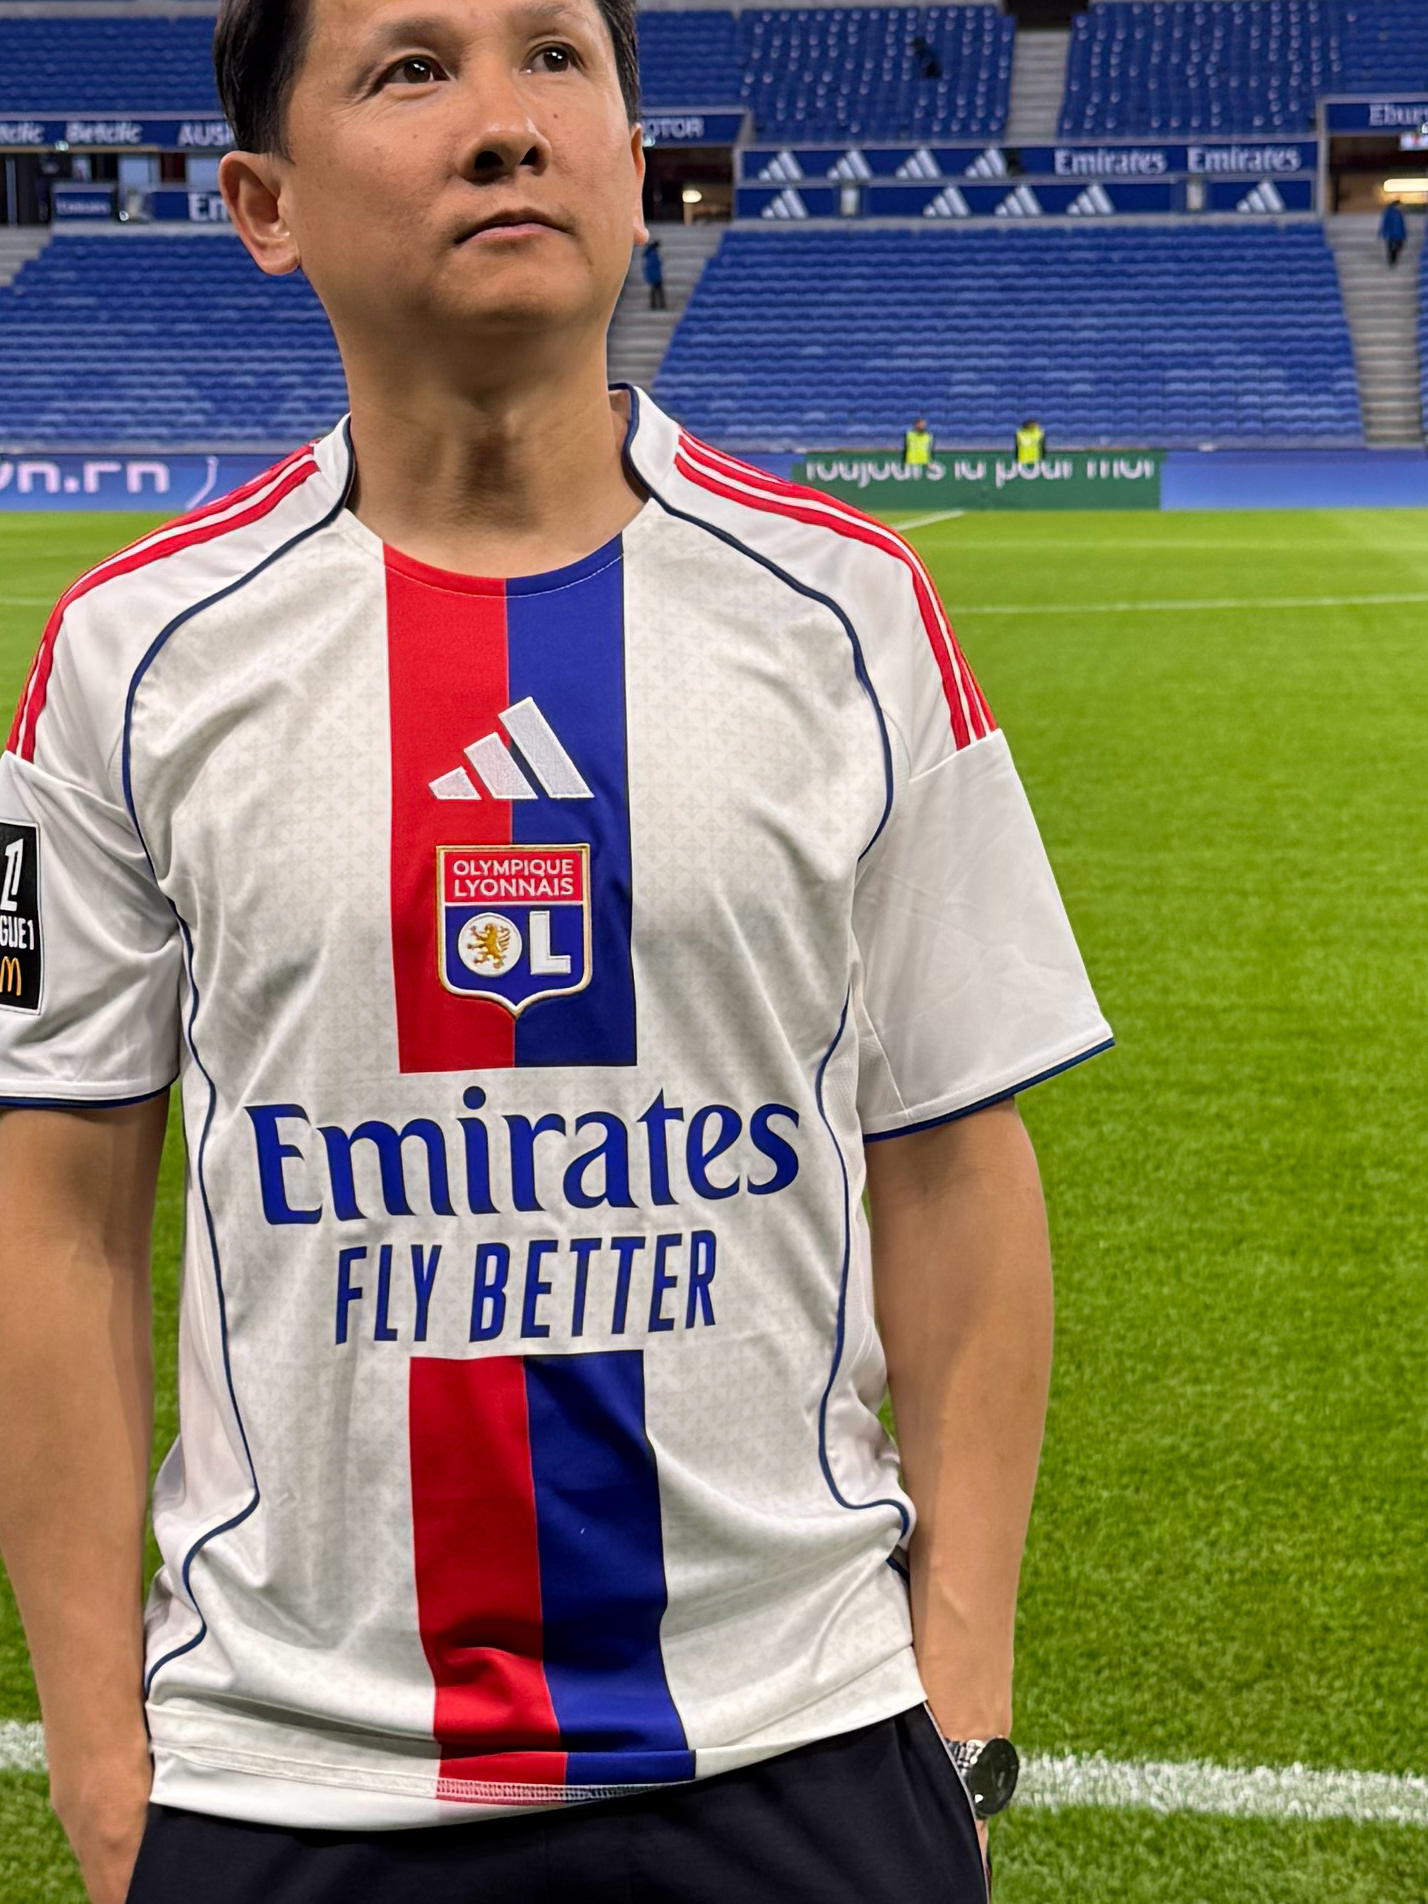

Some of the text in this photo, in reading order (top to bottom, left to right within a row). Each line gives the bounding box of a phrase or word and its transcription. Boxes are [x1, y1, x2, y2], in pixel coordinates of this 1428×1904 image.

[641, 116, 706, 139] OTOR
[1054, 149, 1169, 176] Emirates
[1186, 145, 1302, 173] Emirates
[452, 858, 575, 877] OLYMPIQUE
[453, 877, 575, 897] LYONNAIS
[244, 1085, 802, 1226] Emirates
[334, 1228, 719, 1346] FLY BETTER
